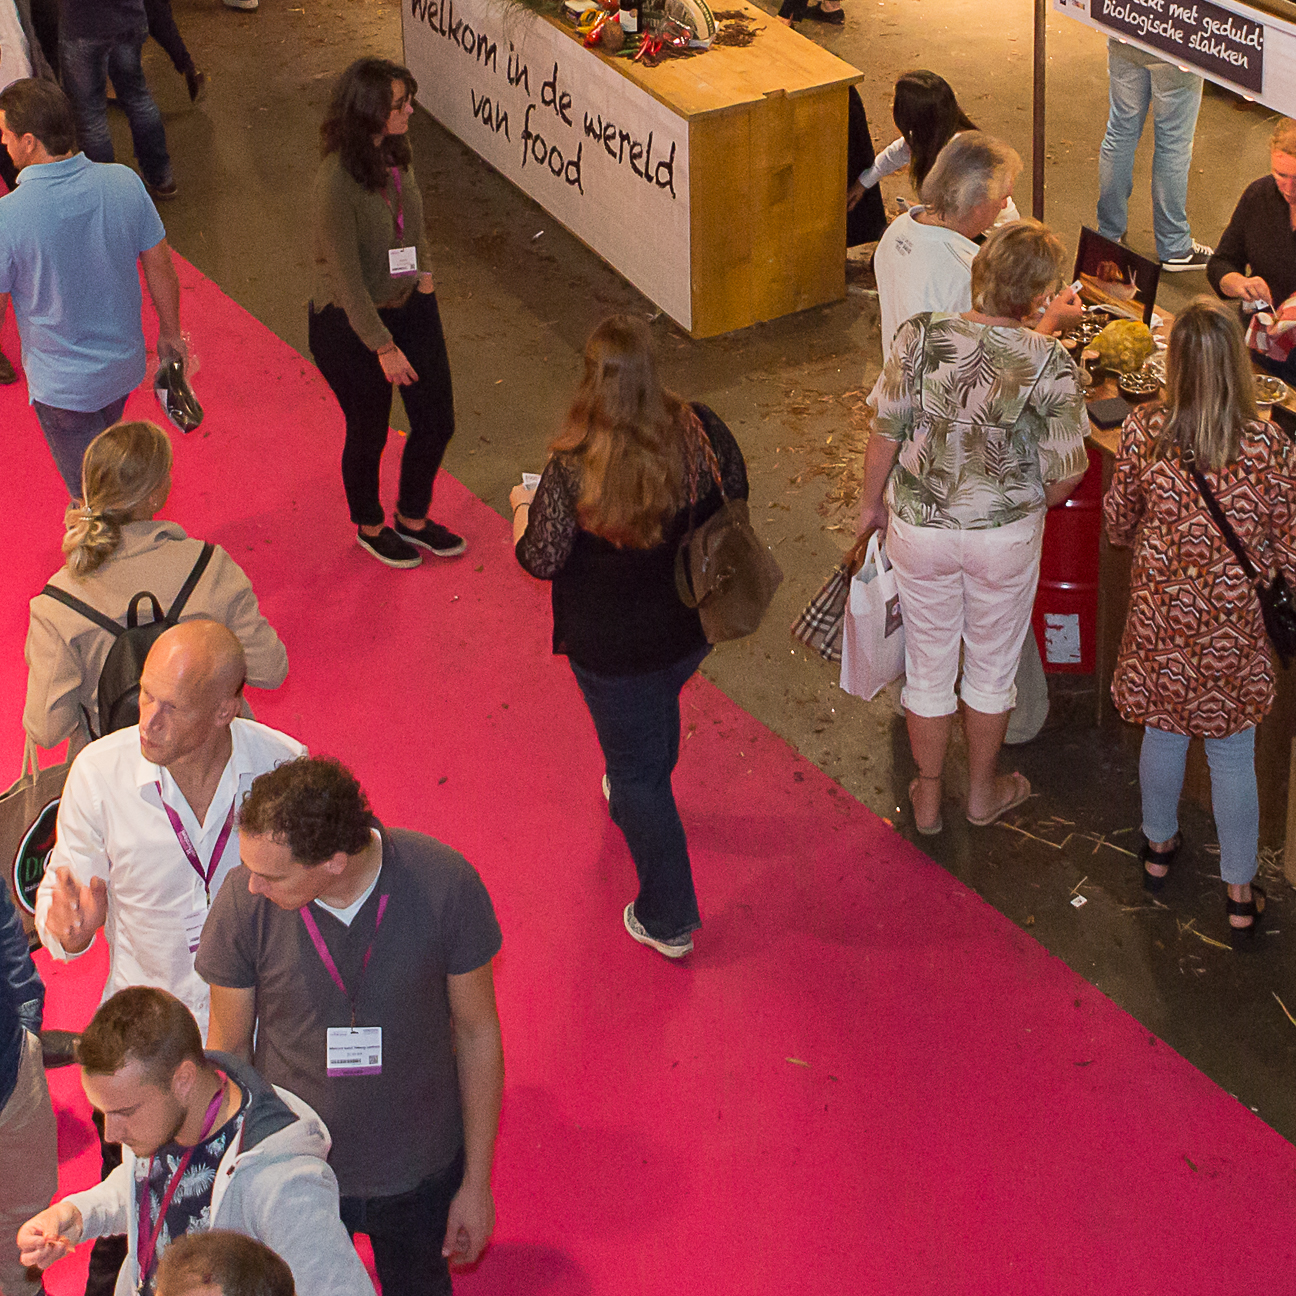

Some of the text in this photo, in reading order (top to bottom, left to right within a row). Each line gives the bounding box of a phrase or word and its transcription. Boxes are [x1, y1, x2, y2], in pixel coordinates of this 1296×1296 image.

[1168, 1, 1199, 26] met
[1188, 33, 1250, 70] slakken
[470, 88, 585, 197] van food
[506, 40, 531, 96] in
[540, 61, 573, 129] de
[583, 108, 678, 200] wereld
